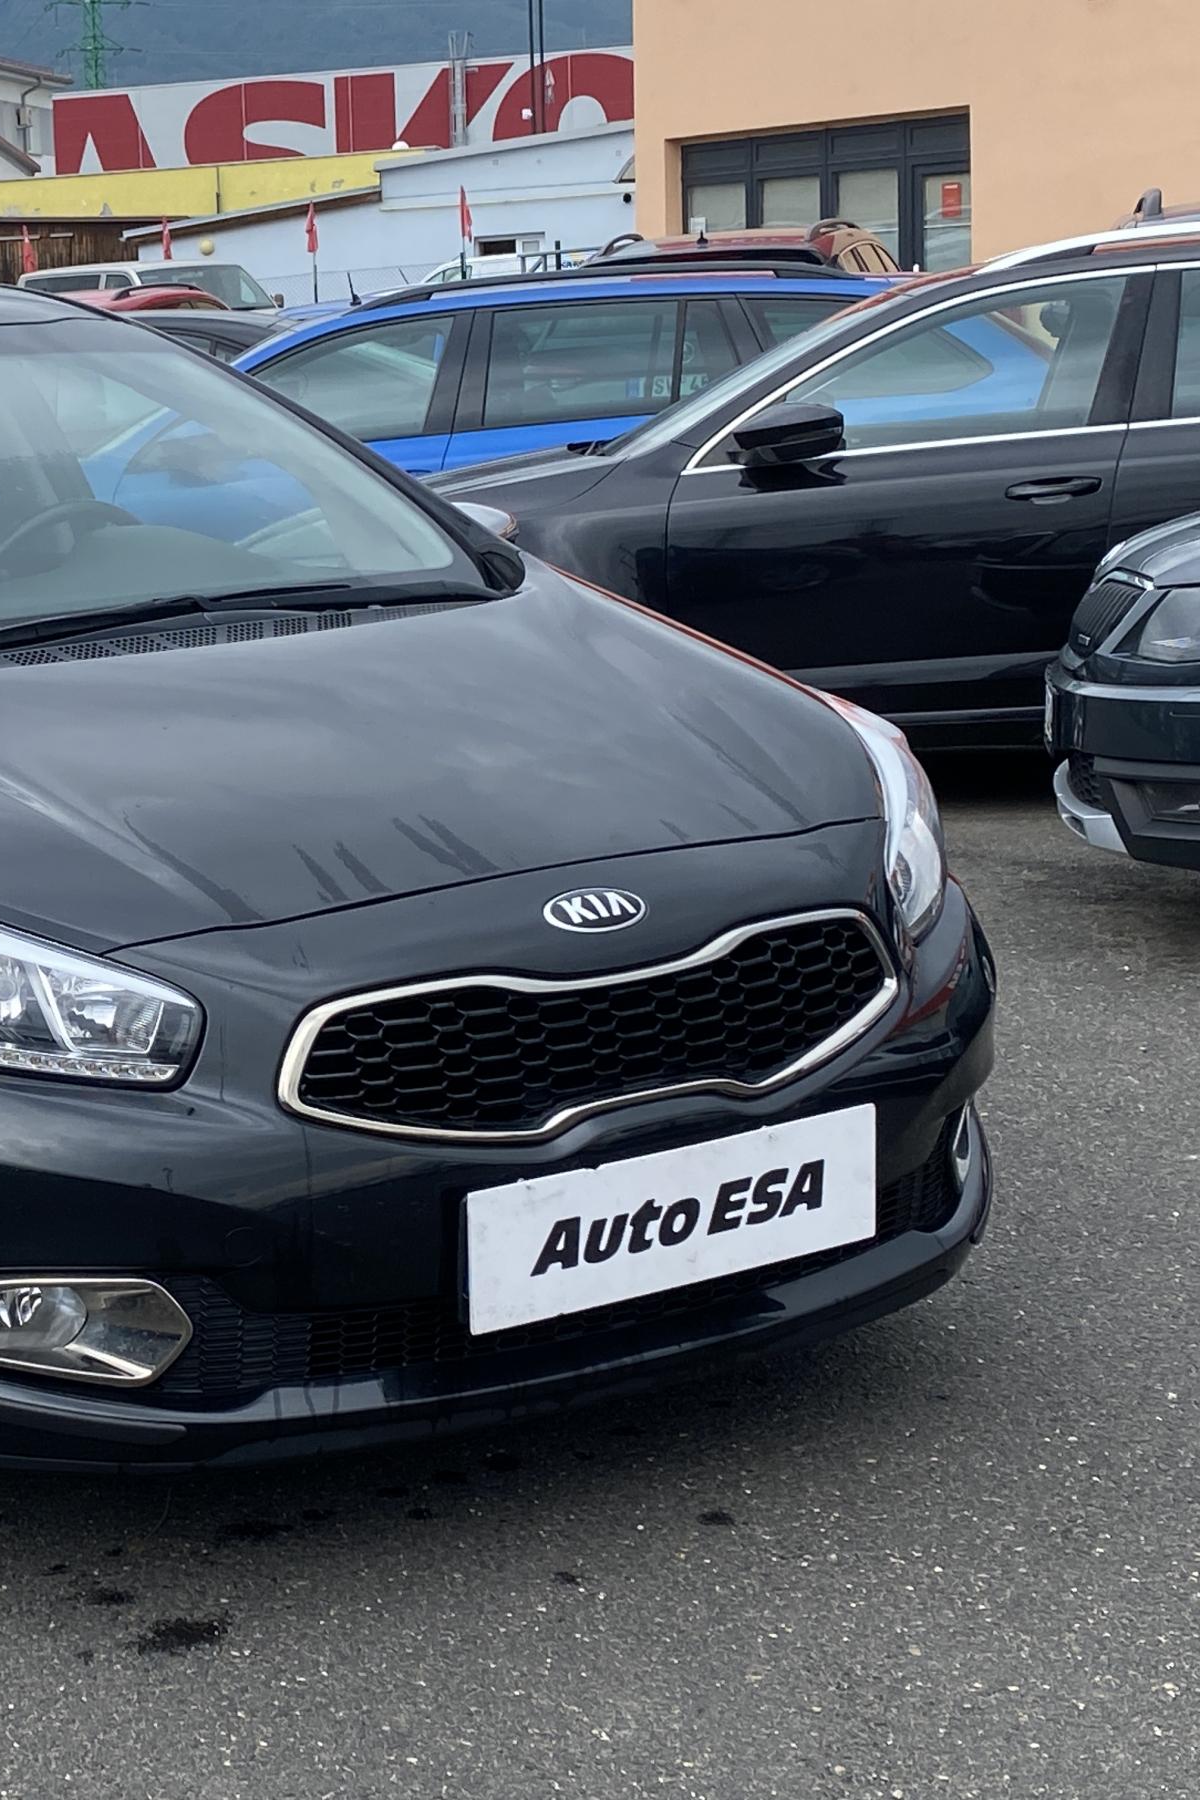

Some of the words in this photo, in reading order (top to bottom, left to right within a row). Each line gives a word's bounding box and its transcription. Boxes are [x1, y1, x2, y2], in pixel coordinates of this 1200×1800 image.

[556, 891, 638, 924] KIA
[530, 1198, 700, 1277] Auto
[707, 1158, 825, 1236] ESA
